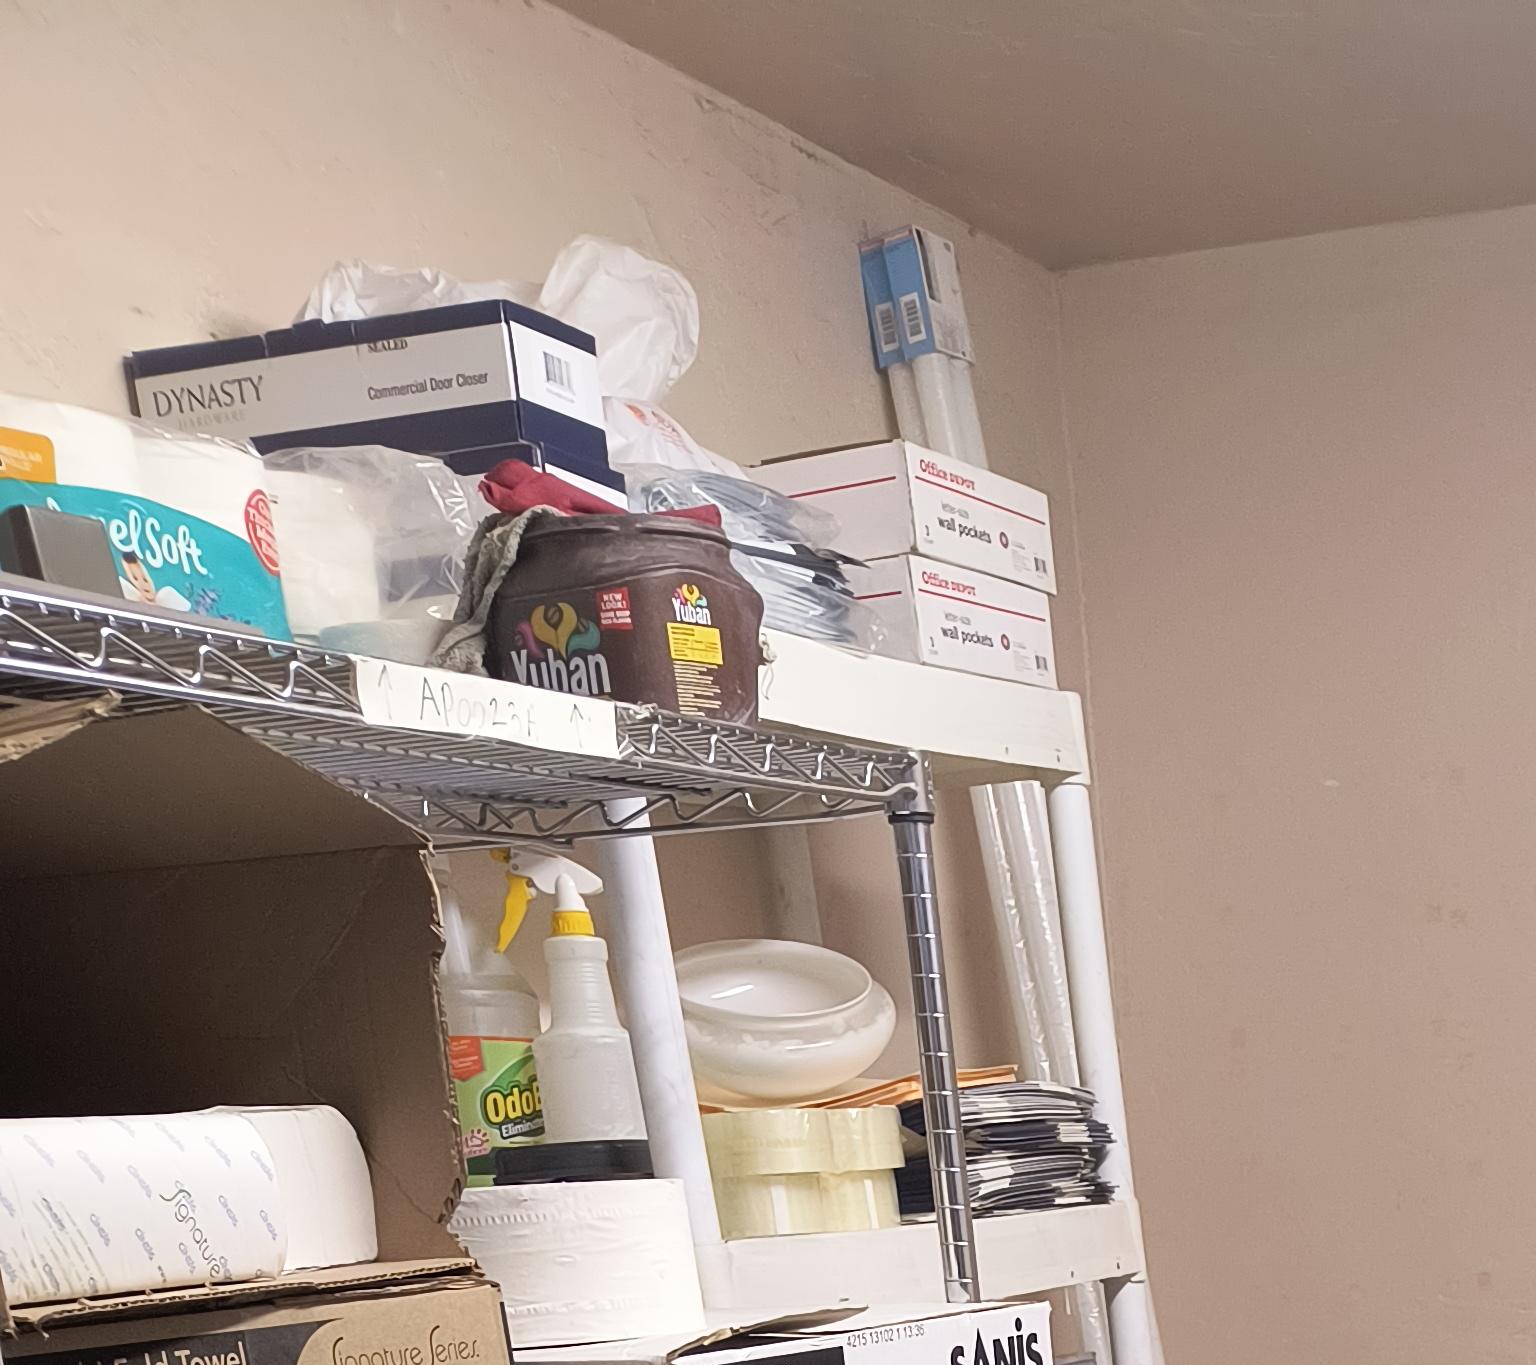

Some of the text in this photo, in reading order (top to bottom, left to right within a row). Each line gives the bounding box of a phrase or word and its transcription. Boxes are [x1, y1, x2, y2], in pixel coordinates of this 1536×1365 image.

[153, 375, 263, 417] DYNASTY
[368, 371, 489, 400] Commercial Door Closer
[920, 459, 949, 482] Office
[937, 516, 992, 544] wall pockets
[145, 516, 208, 575] Soft
[921, 571, 950, 590] Office
[672, 597, 712, 625] Yuban
[940, 625, 994, 649] wall pockets
[510, 648, 612, 696] Yuban
[160, 1189, 221, 1279] Signature
[846, 1333, 869, 1350] 4215
